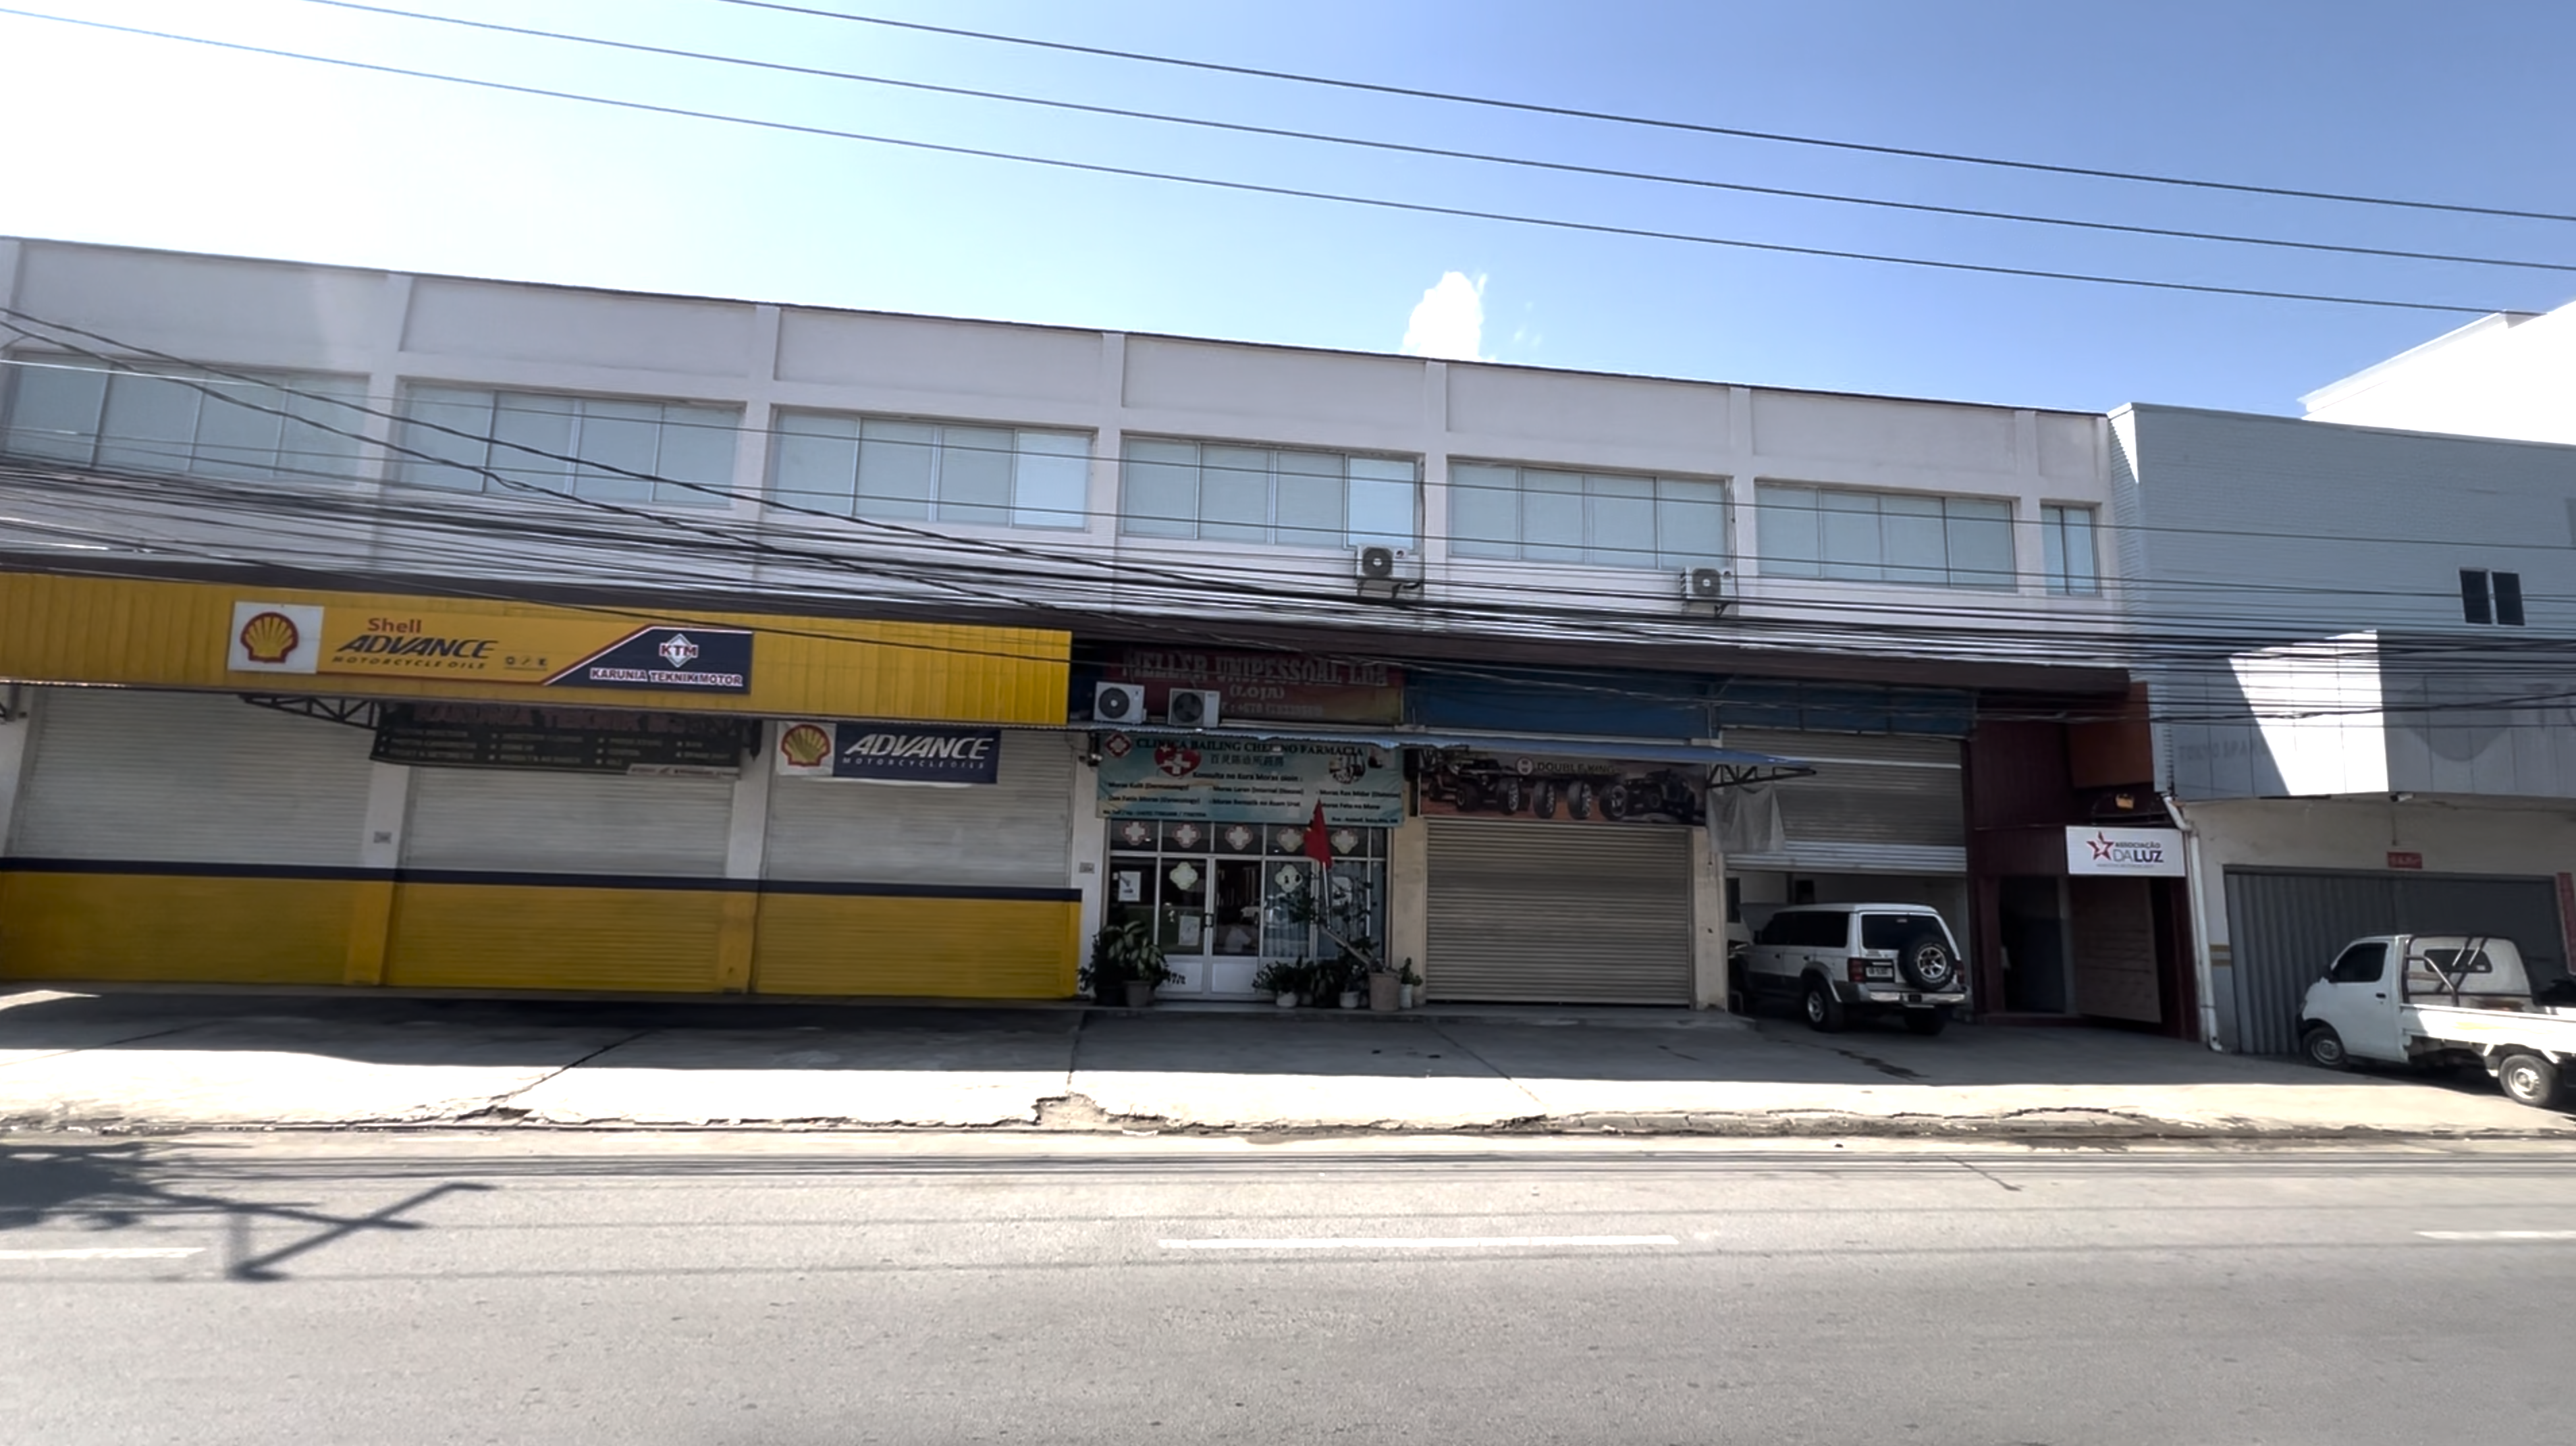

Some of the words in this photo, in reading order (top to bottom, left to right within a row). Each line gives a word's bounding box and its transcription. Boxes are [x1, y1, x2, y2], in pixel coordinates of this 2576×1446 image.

[367, 617, 422, 633] Shell
[336, 635, 499, 659] ADVANCE
[659, 643, 699, 658] KTM
[331, 655, 442, 668] MOTORCYCLE
[448, 661, 487, 669] OILS
[589, 667, 648, 682] KARUNIA
[649, 670, 697, 684] TEKNIK
[697, 673, 743, 687] MOTOR
[844, 733, 994, 760] ADVANCE
[1191, 740, 1241, 751] BAILING
[1300, 745, 1364, 756] FARMACIA
[842, 757, 944, 768] MOTORCYCLE
[950, 761, 985, 769] OILS
[1536, 761, 1584, 772] DOUBLE
